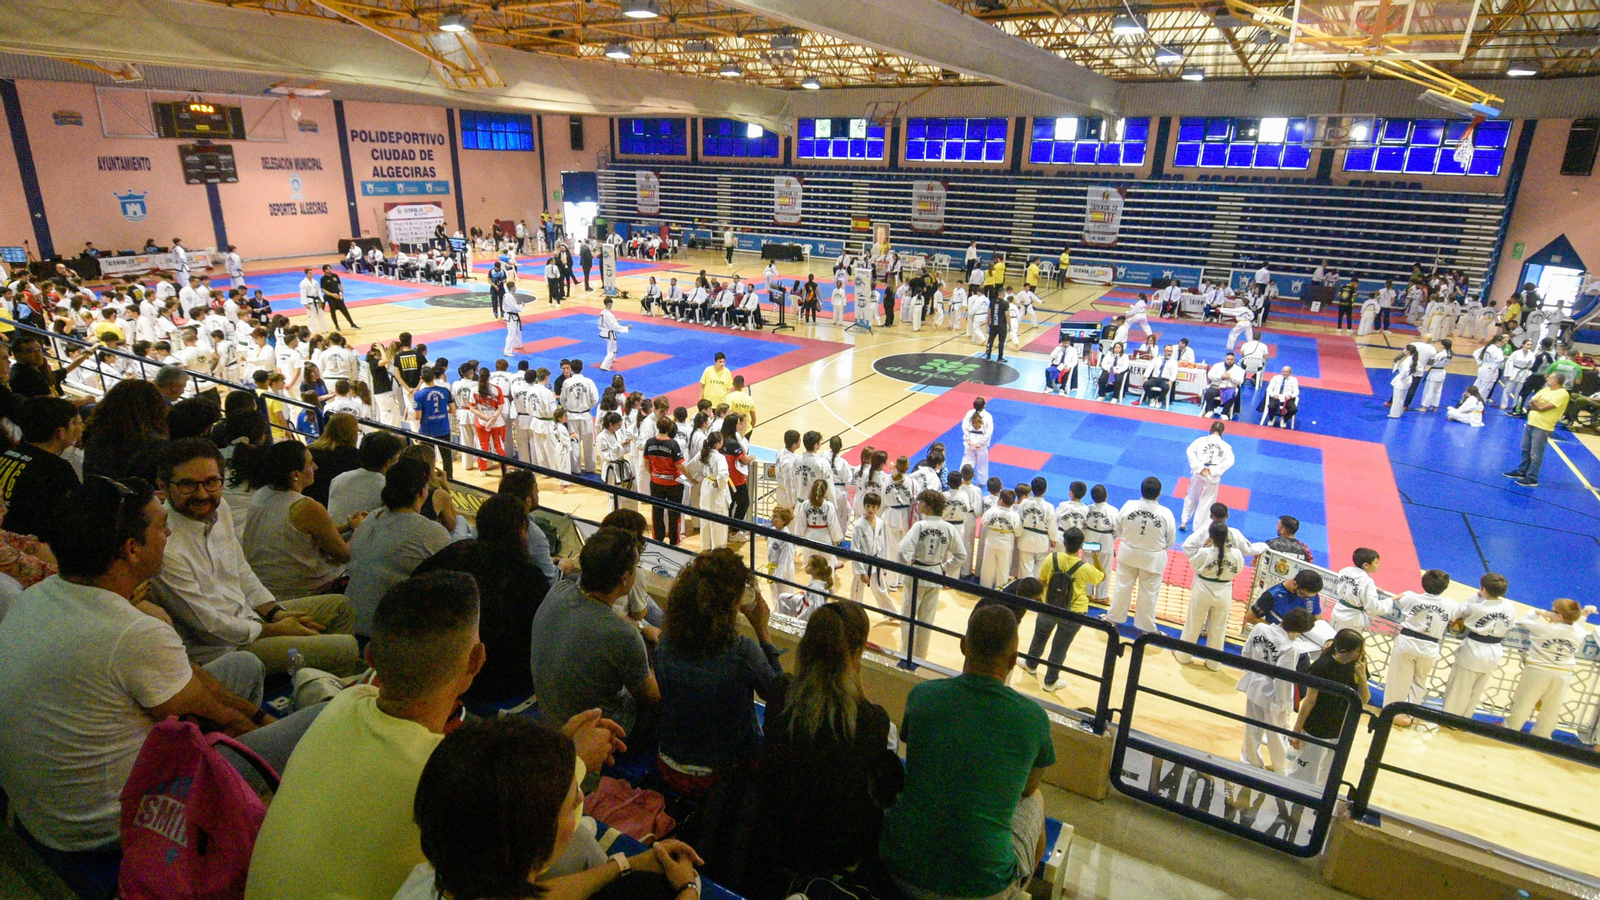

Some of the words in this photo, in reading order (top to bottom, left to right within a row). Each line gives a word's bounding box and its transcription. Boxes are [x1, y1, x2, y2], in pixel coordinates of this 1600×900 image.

[350, 129, 445, 146] POLIDEPORTIVO
[371, 148, 416, 161] CIUDAD
[419, 149, 434, 161] DE
[97, 156, 151, 171] AYUNTAMIENTO
[261, 156, 293, 171] DELEGACION
[294, 157, 323, 171] MUNICIPAL
[372, 166, 437, 178] ALGECIRAS
[269, 203, 297, 216] DEPORTES
[300, 202, 328, 216] ALGECIRAS
